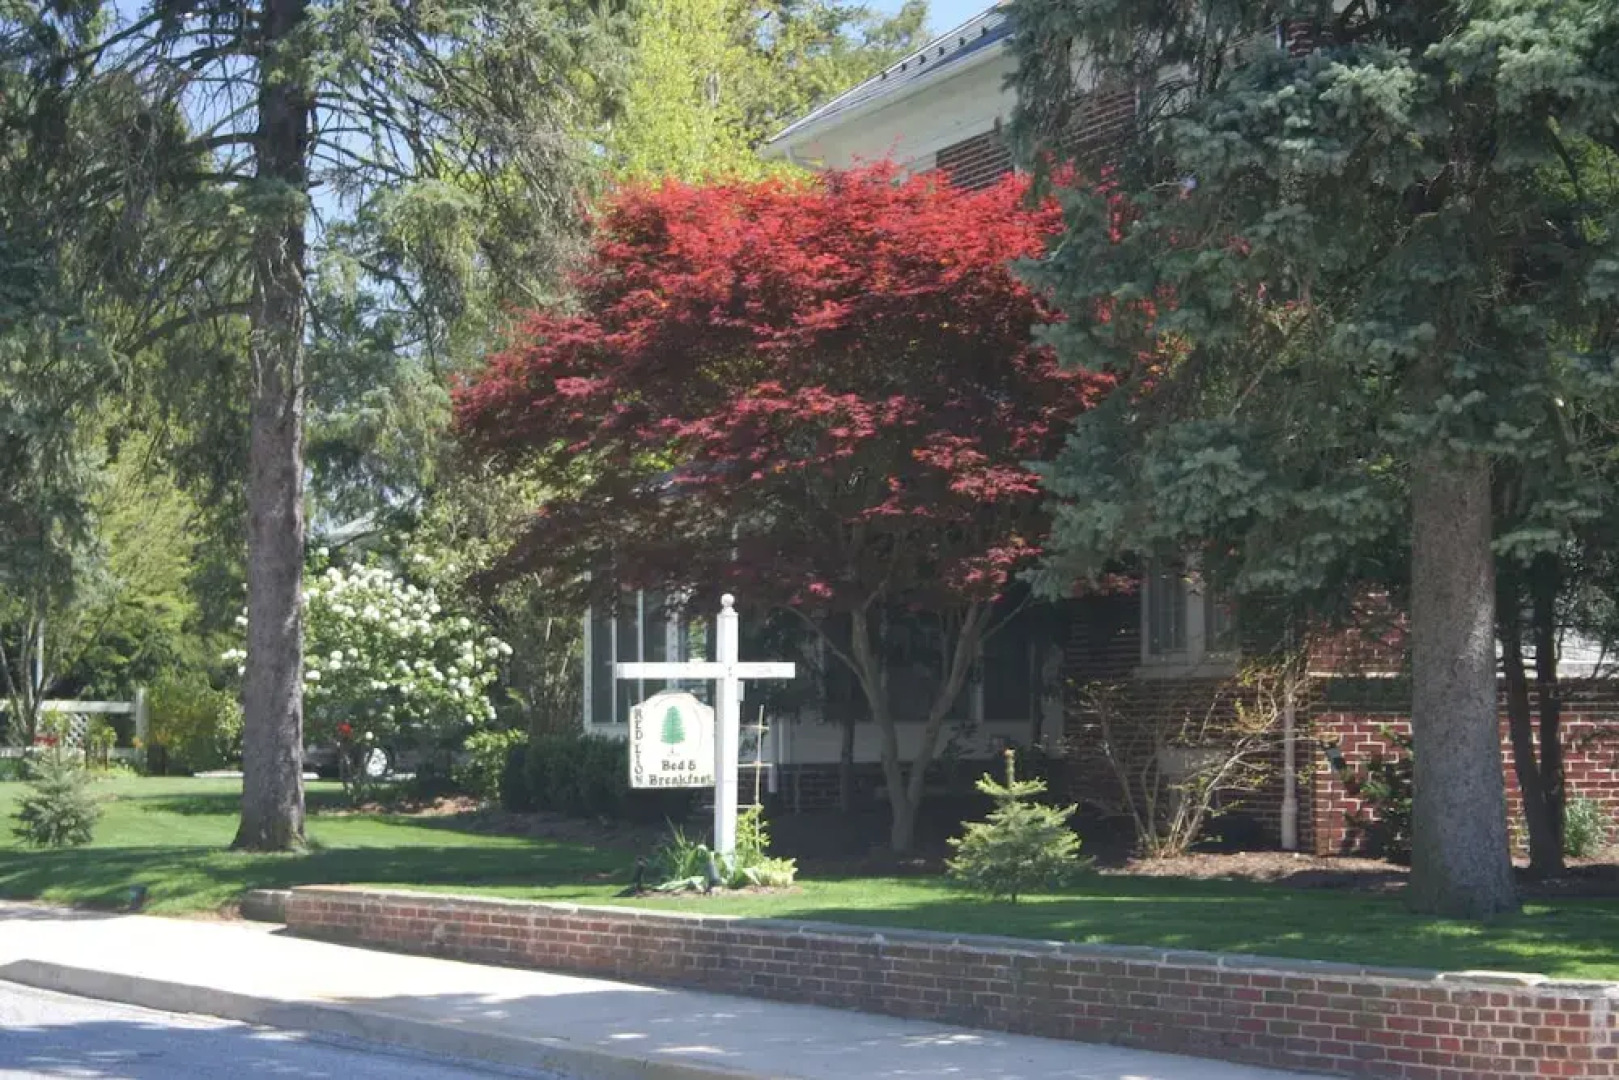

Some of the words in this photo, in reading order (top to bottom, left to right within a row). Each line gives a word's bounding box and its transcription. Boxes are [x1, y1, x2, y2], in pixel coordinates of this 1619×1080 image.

[634, 708, 643, 740] RED
[634, 745, 643, 784] LION
[661, 759, 684, 771] Bed
[648, 774, 713, 786] Breakfast
